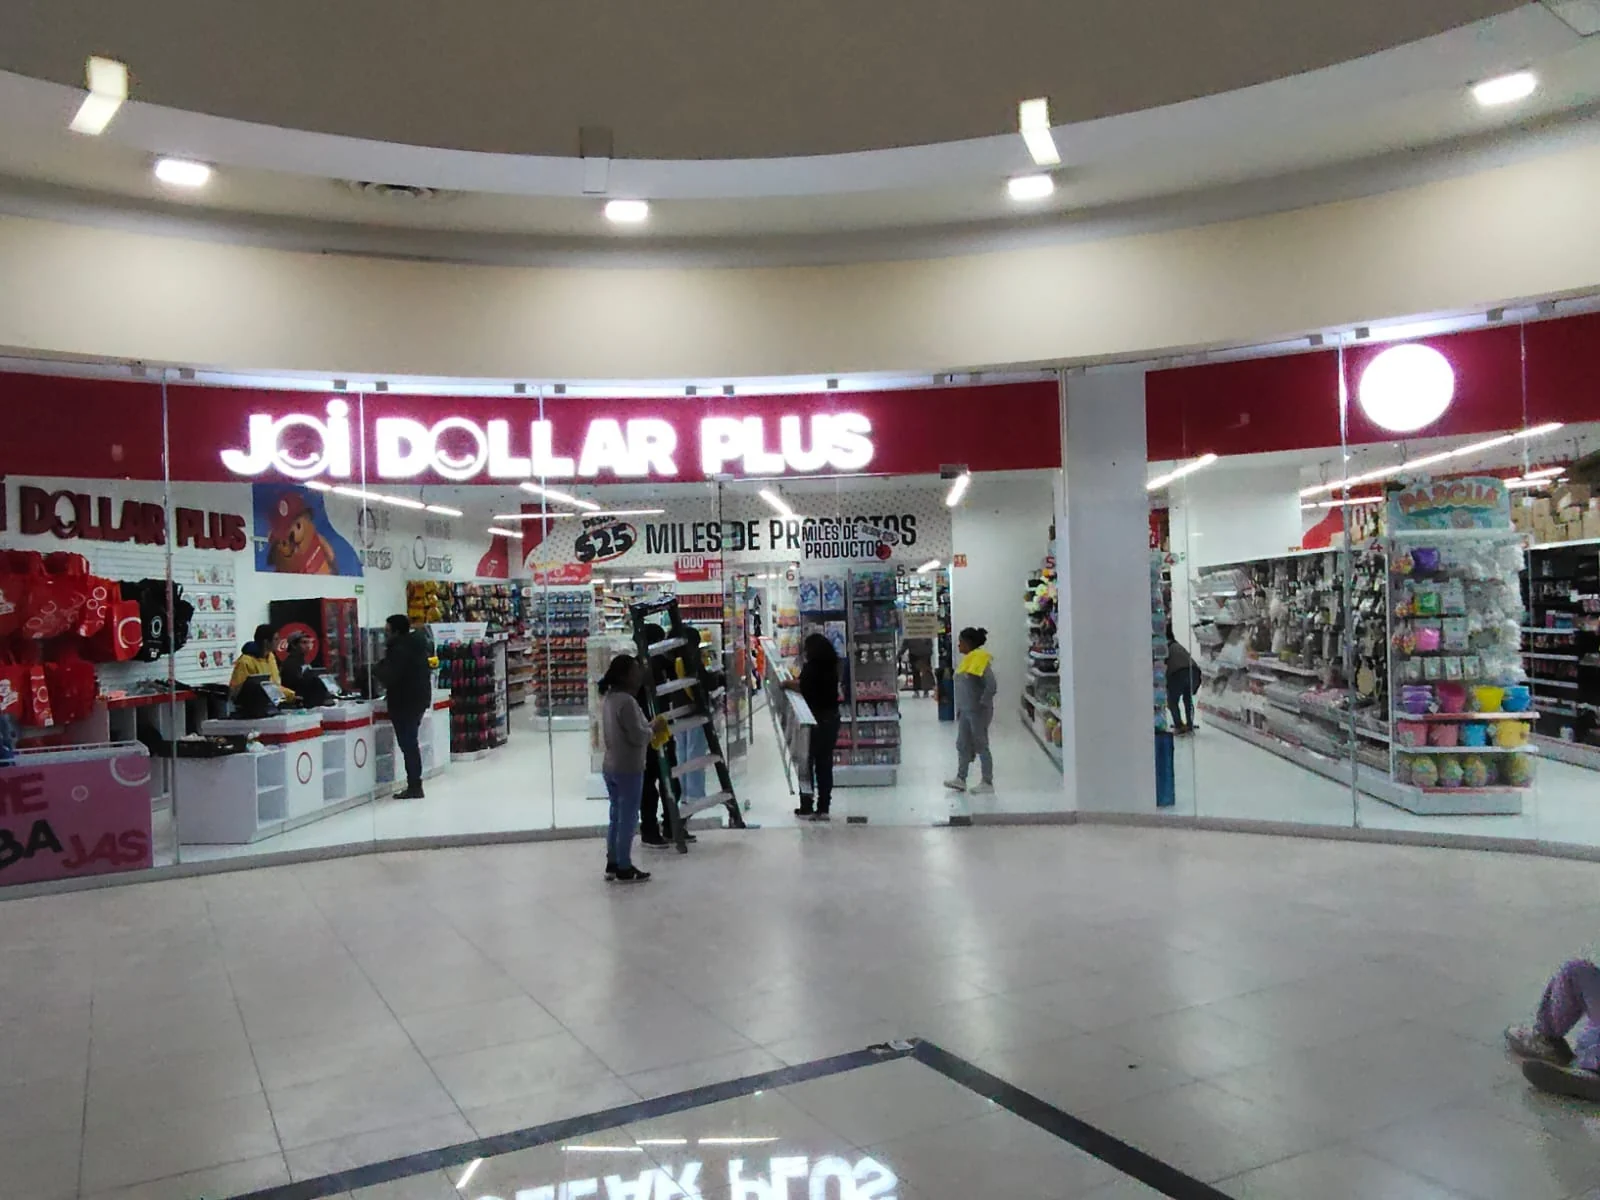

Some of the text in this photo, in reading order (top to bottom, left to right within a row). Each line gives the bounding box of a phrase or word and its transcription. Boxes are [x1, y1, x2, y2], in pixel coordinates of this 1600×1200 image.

[376, 416, 679, 480] DOLLAR
[701, 412, 875, 475] PLUS
[19, 485, 166, 546] DOLLAR
[176, 507, 247, 552] PLUS
[646, 514, 916, 554] MILES DE PRTOS
[802, 524, 839, 542] MILES
[843, 525, 859, 540] DE
[575, 523, 632, 563] $25
[785, 570, 795, 581] 6
